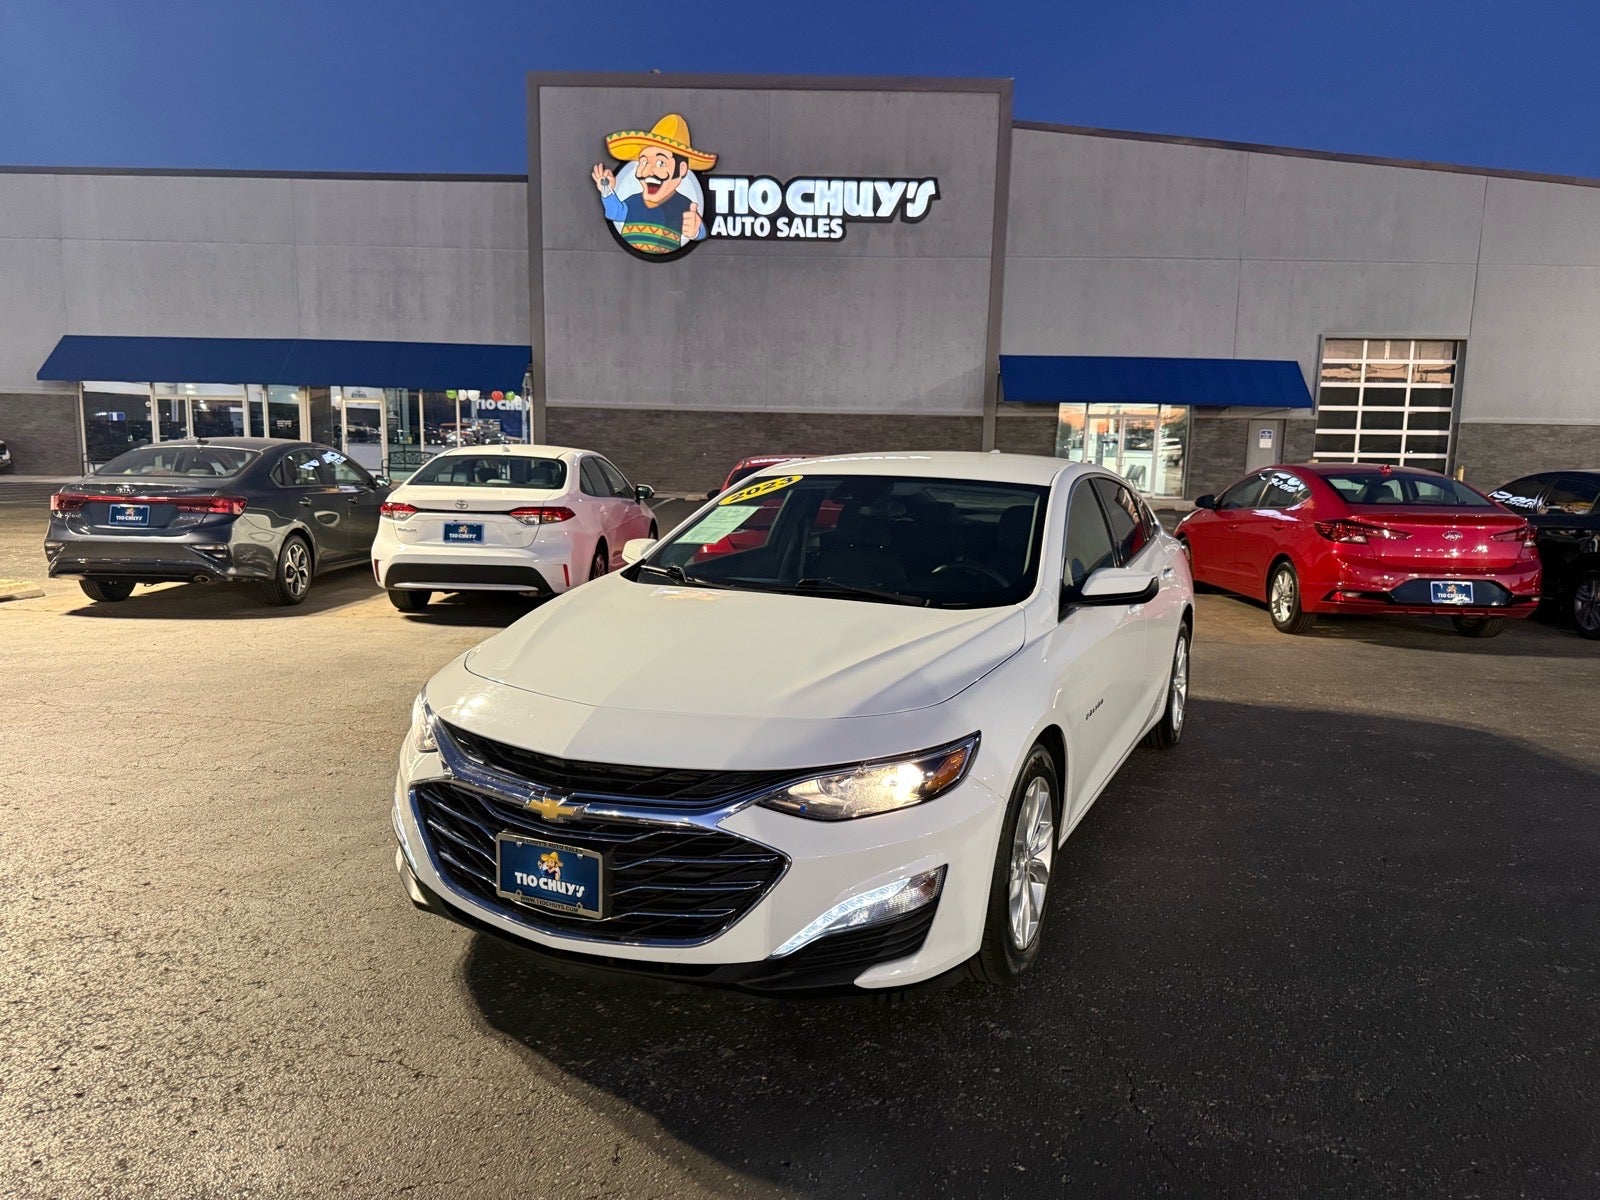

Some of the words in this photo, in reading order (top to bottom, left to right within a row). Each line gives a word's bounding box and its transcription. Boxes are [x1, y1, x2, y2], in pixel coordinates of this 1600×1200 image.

[708, 178, 782, 215] TIO
[786, 180, 936, 218] CHUY'S
[711, 216, 771, 237] AUTO
[776, 218, 843, 239] SALES
[729, 478, 792, 502] 2023
[514, 871, 538, 888] TIO
[538, 877, 585, 898] CHUY'S
